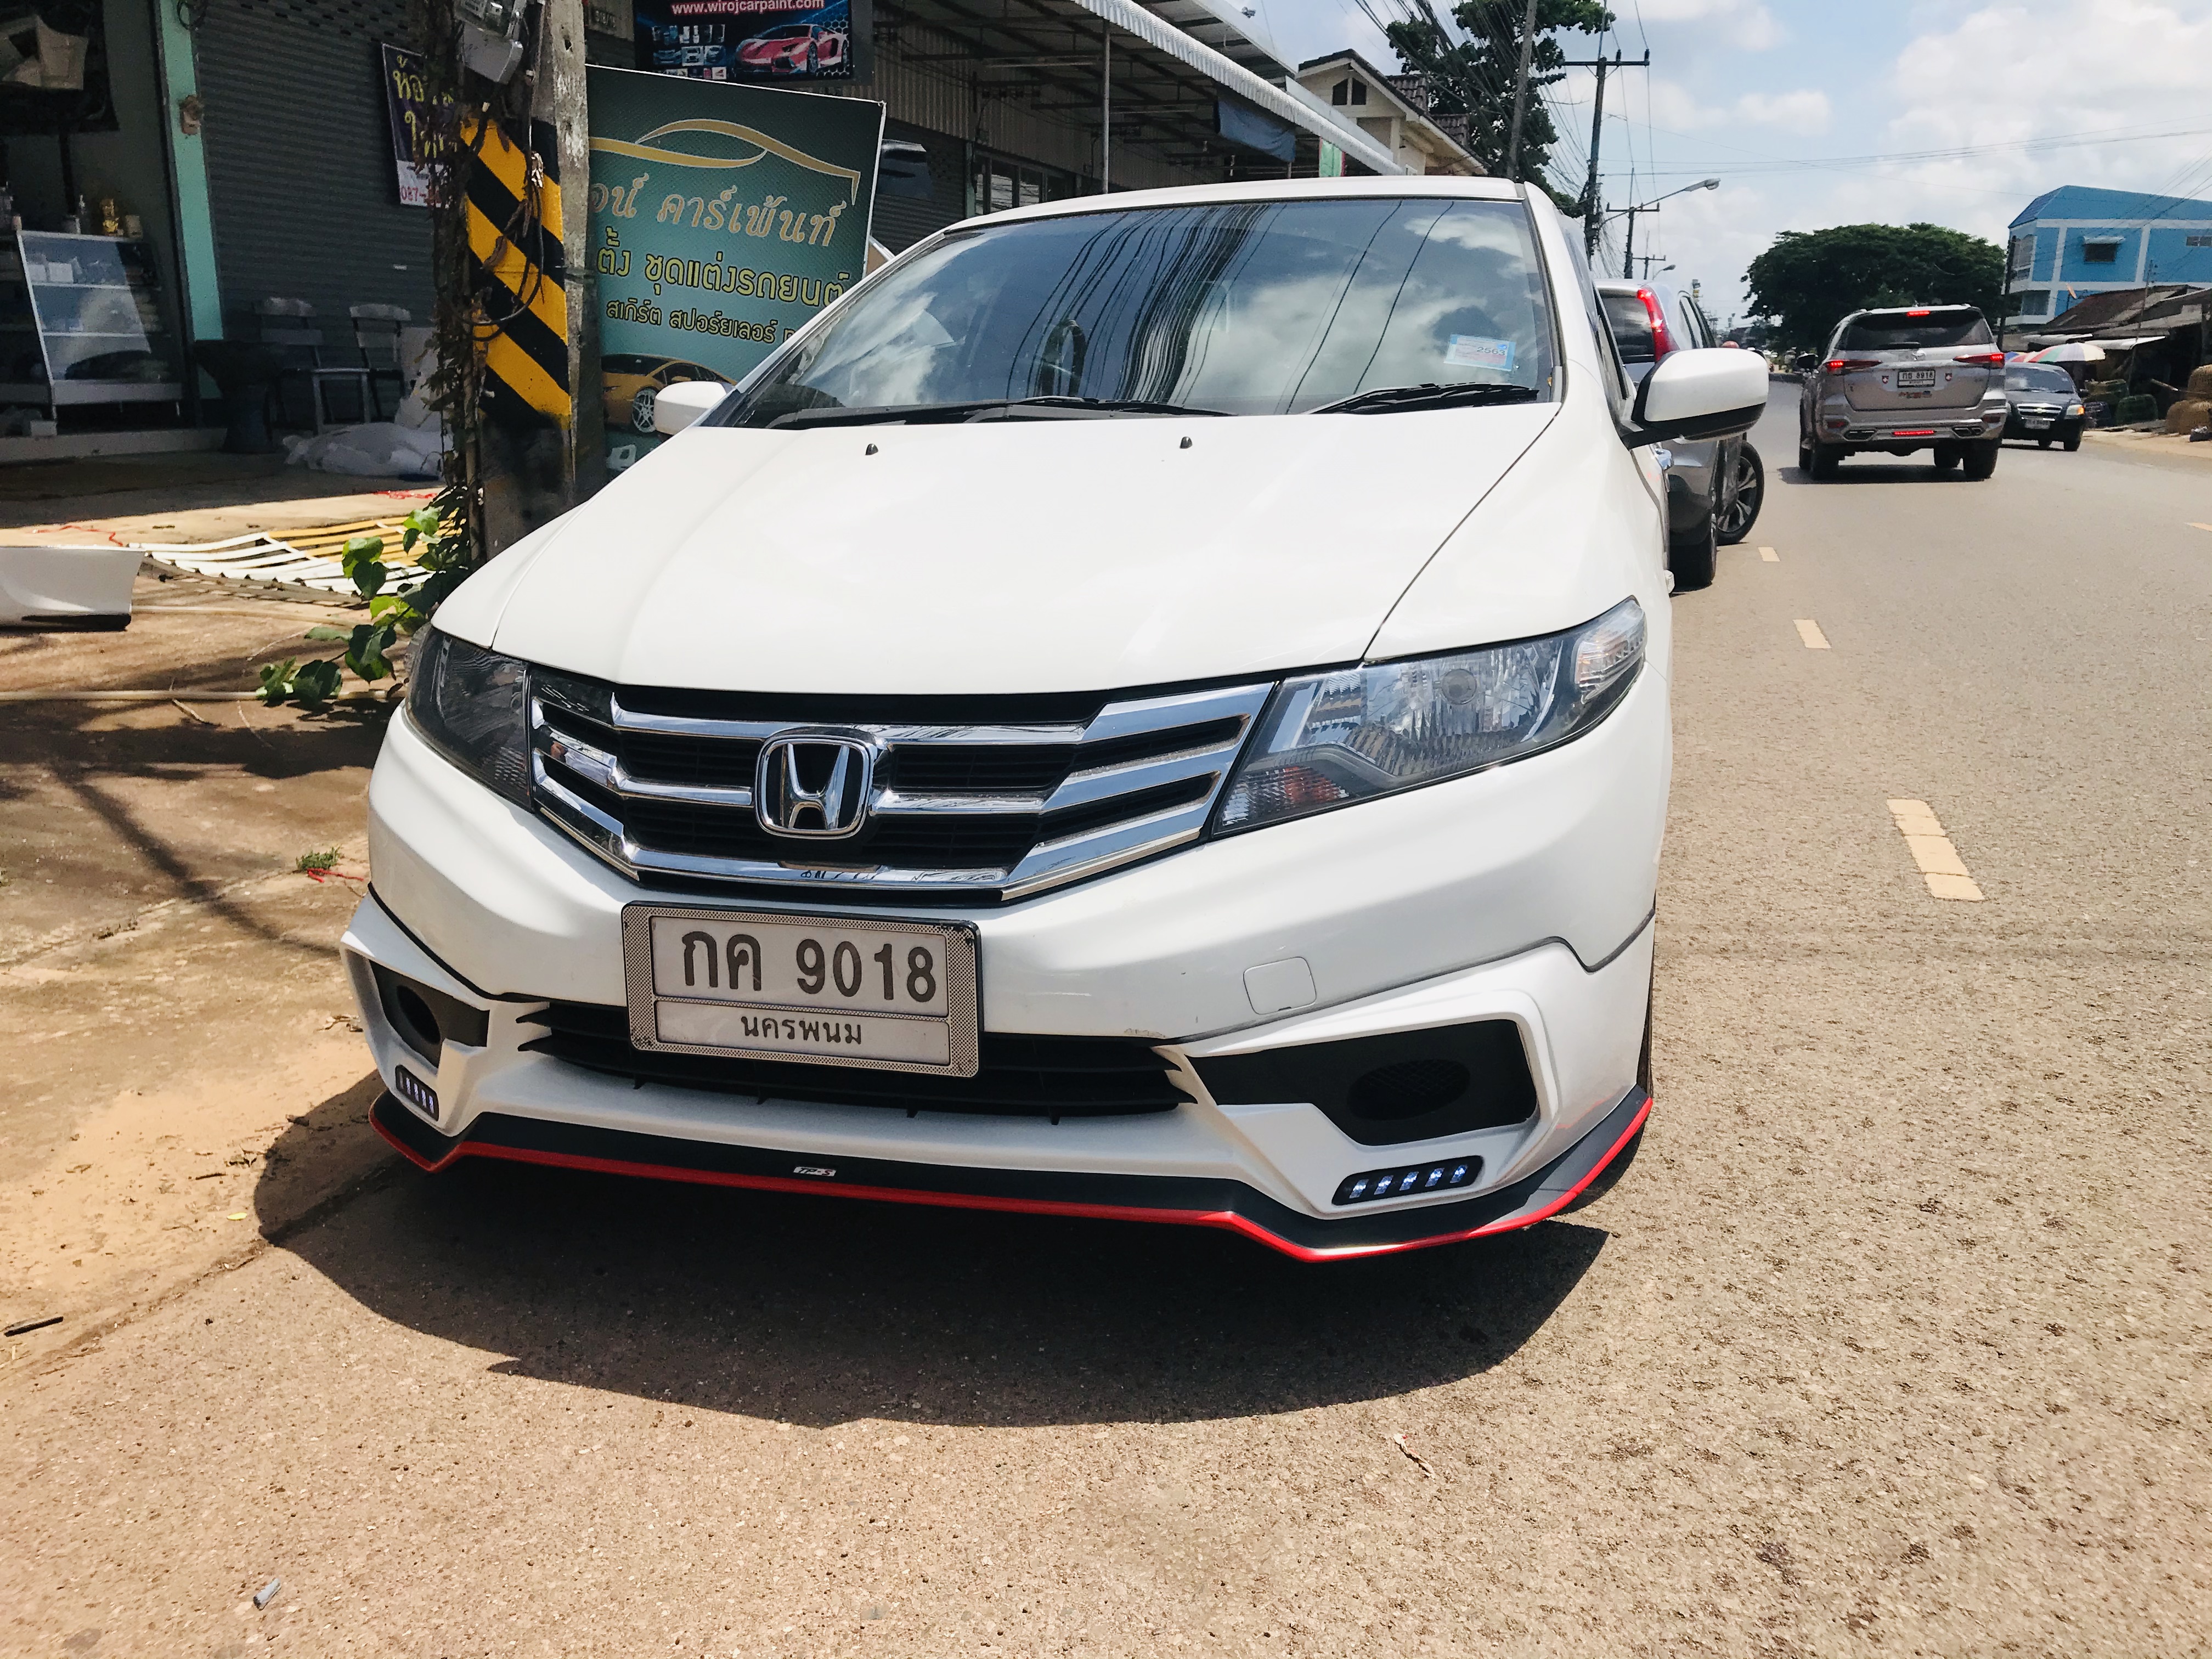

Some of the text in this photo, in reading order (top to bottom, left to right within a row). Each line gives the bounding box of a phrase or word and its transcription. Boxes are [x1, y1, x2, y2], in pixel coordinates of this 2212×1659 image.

[657, 184, 847, 247] คาร์เพ้นท์
[597, 225, 850, 307] ตั้ง ชุดแต่งรถยนต์
[606, 297, 663, 326] สเกิร์ต
[669, 307, 779, 344] สปอร์ยเลอร์
[1476, 347, 1505, 356] 2563
[681, 930, 936, 1002] กค 9018
[741, 1015, 862, 1045] นครพนม
